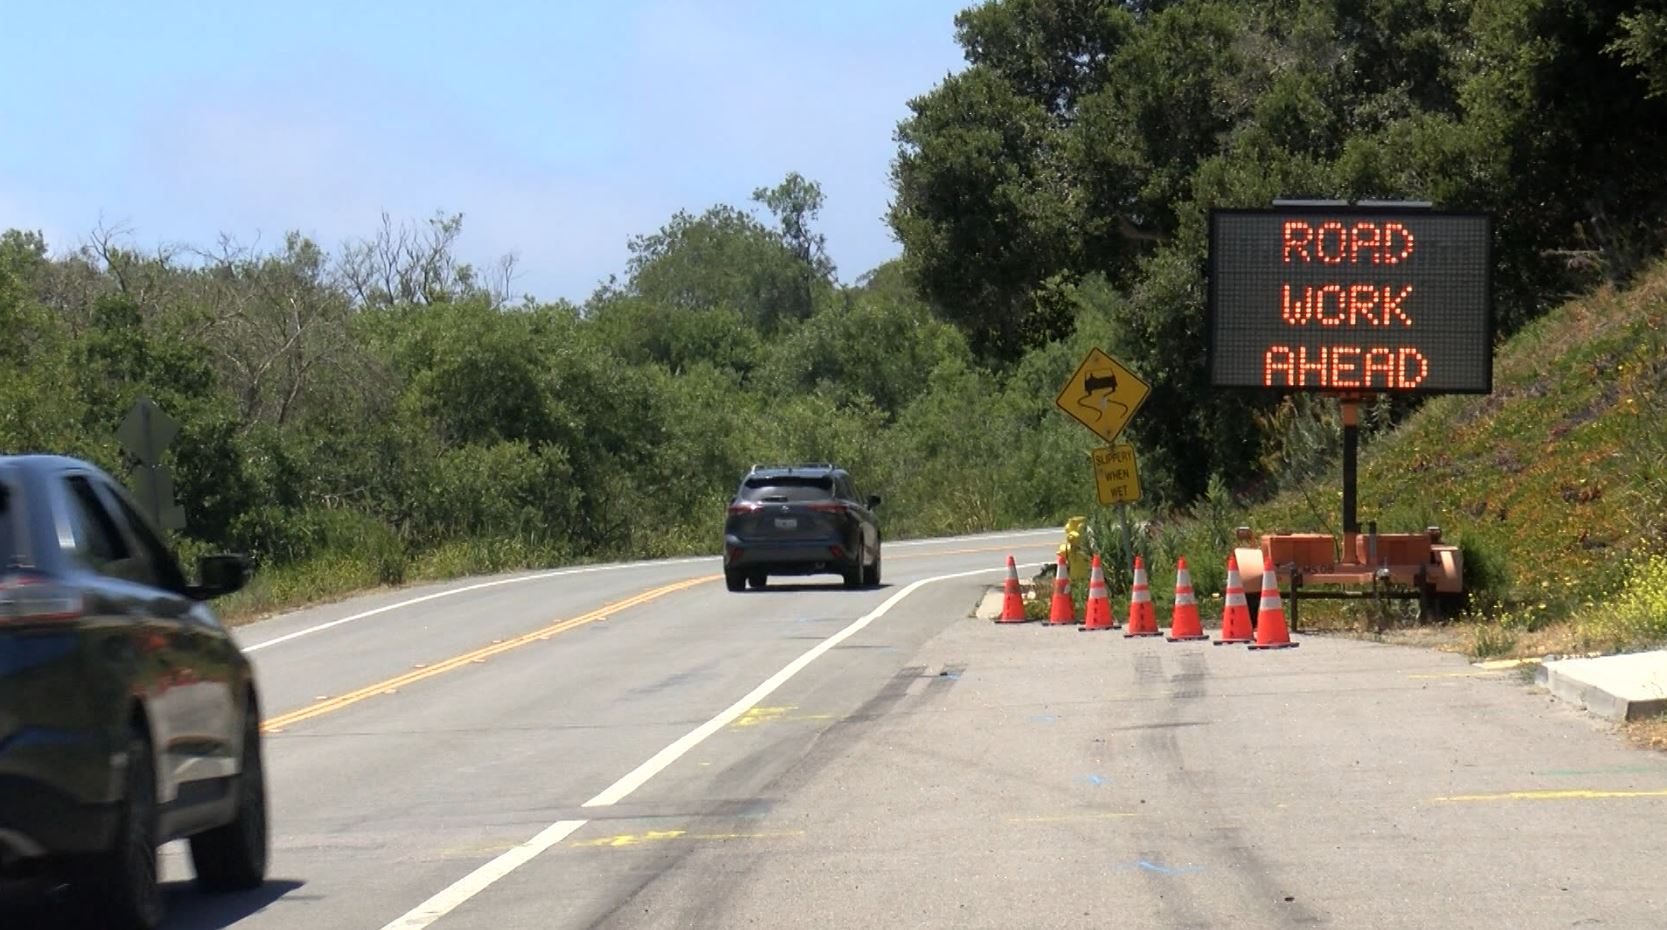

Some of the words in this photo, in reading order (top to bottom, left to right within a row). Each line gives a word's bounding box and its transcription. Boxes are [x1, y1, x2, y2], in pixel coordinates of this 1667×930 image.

[1283, 221, 1415, 264] ROAD
[1282, 284, 1414, 326] WORK
[1264, 346, 1428, 388] AHEAD
[1095, 451, 1131, 466] SLIPPERY
[1105, 468, 1130, 482] WHEN
[1110, 485, 1127, 498] WET
